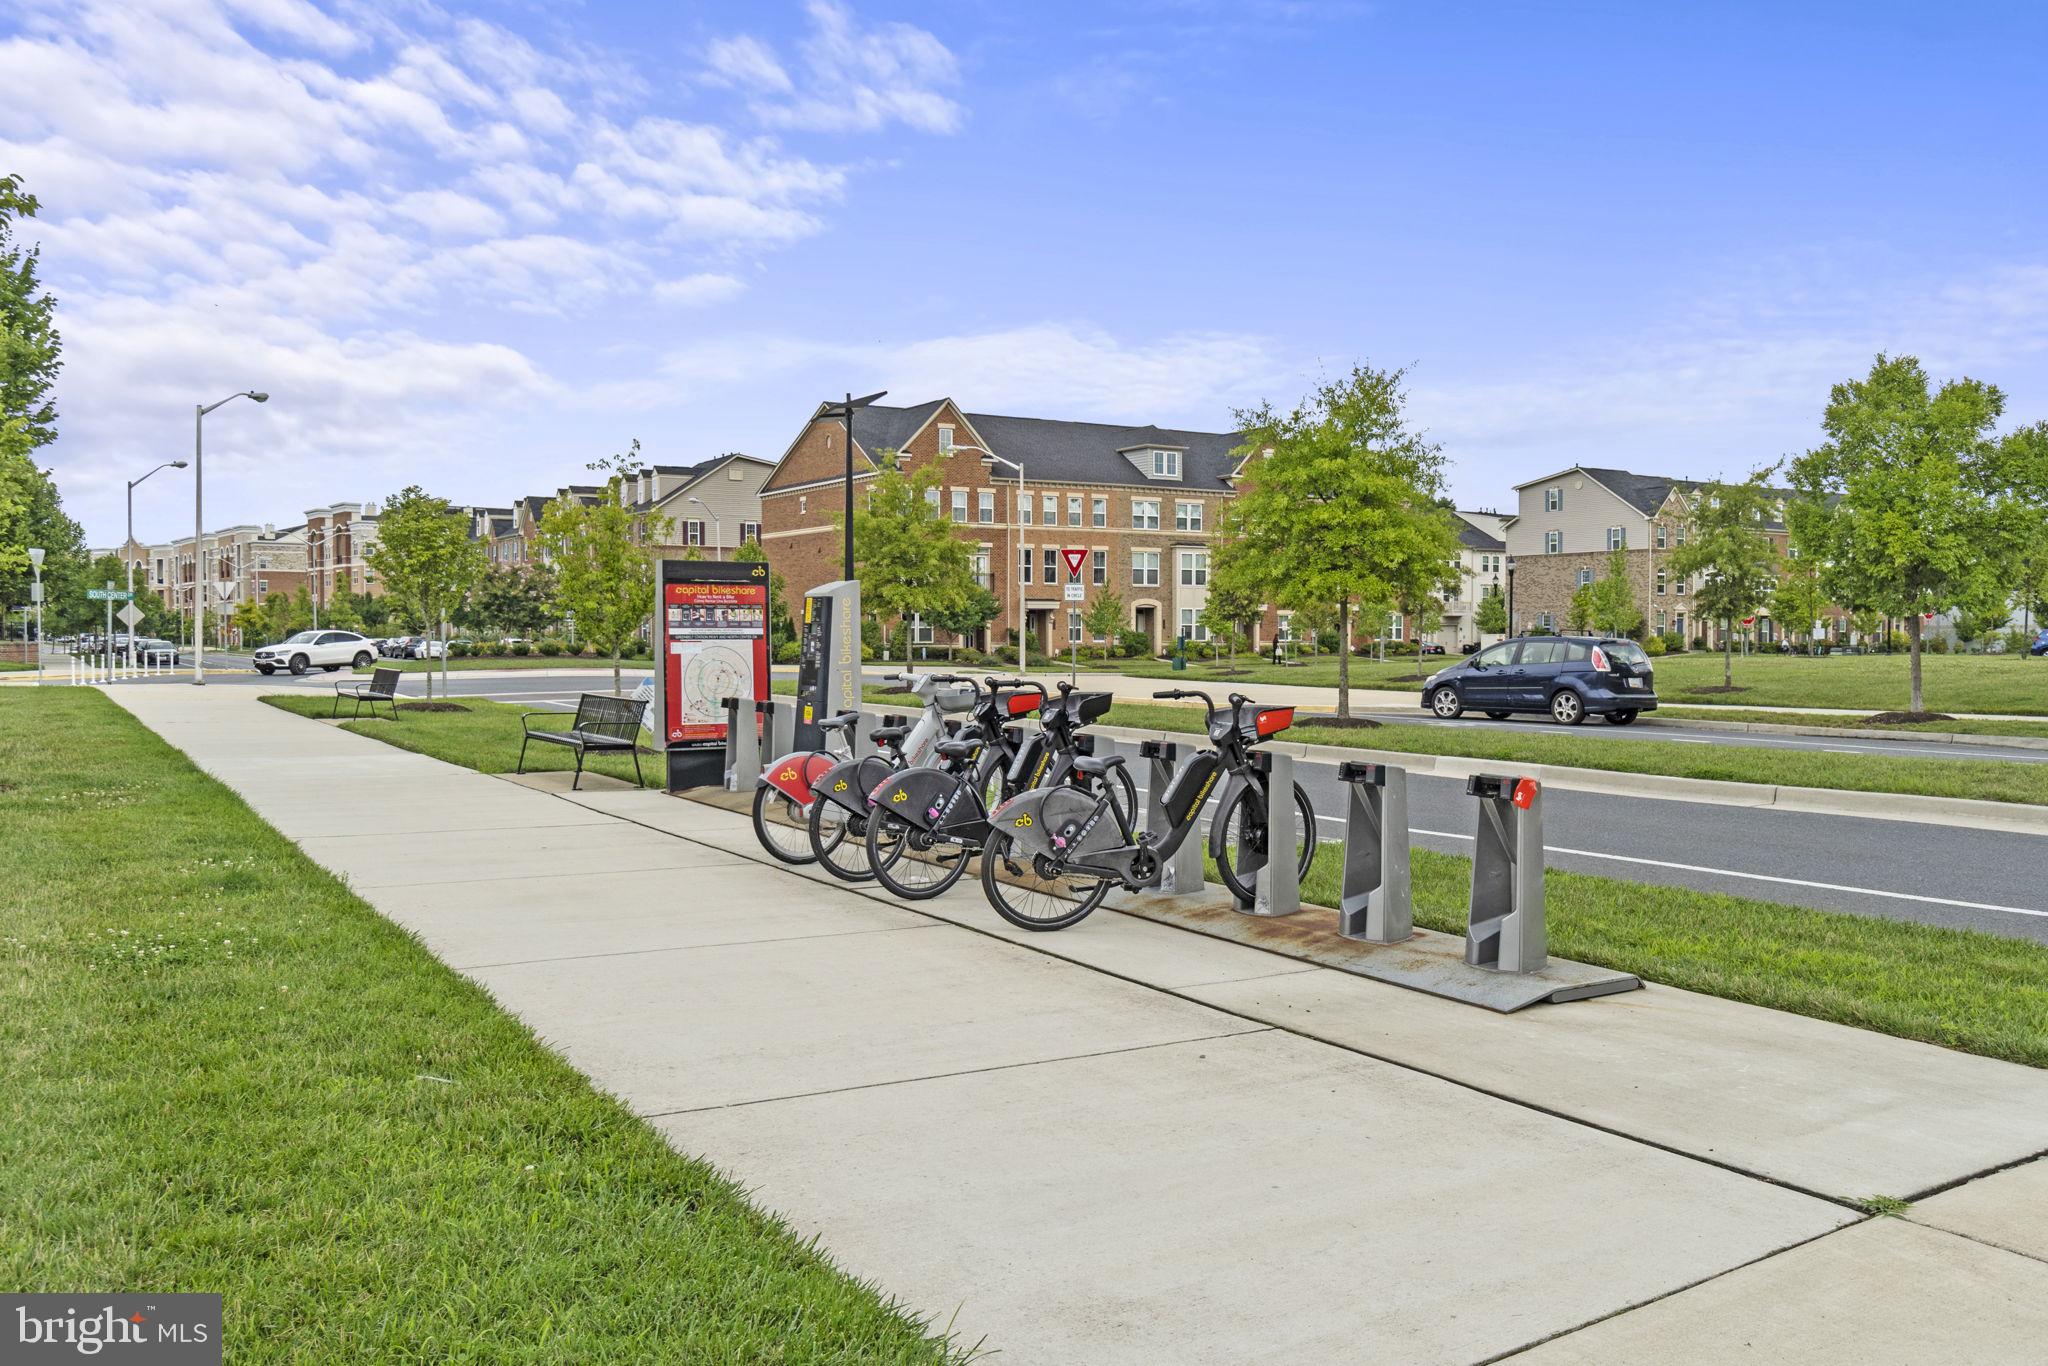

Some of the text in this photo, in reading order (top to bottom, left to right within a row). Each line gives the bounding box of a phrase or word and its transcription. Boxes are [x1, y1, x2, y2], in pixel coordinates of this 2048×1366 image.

[88, 590, 106, 599] SOUTH
[107, 591, 128, 600] CENTER
[676, 585, 756, 596] capital bikeshare
[839, 597, 853, 664] bikeshare
[1186, 771, 1218, 821] capital bikeshare
